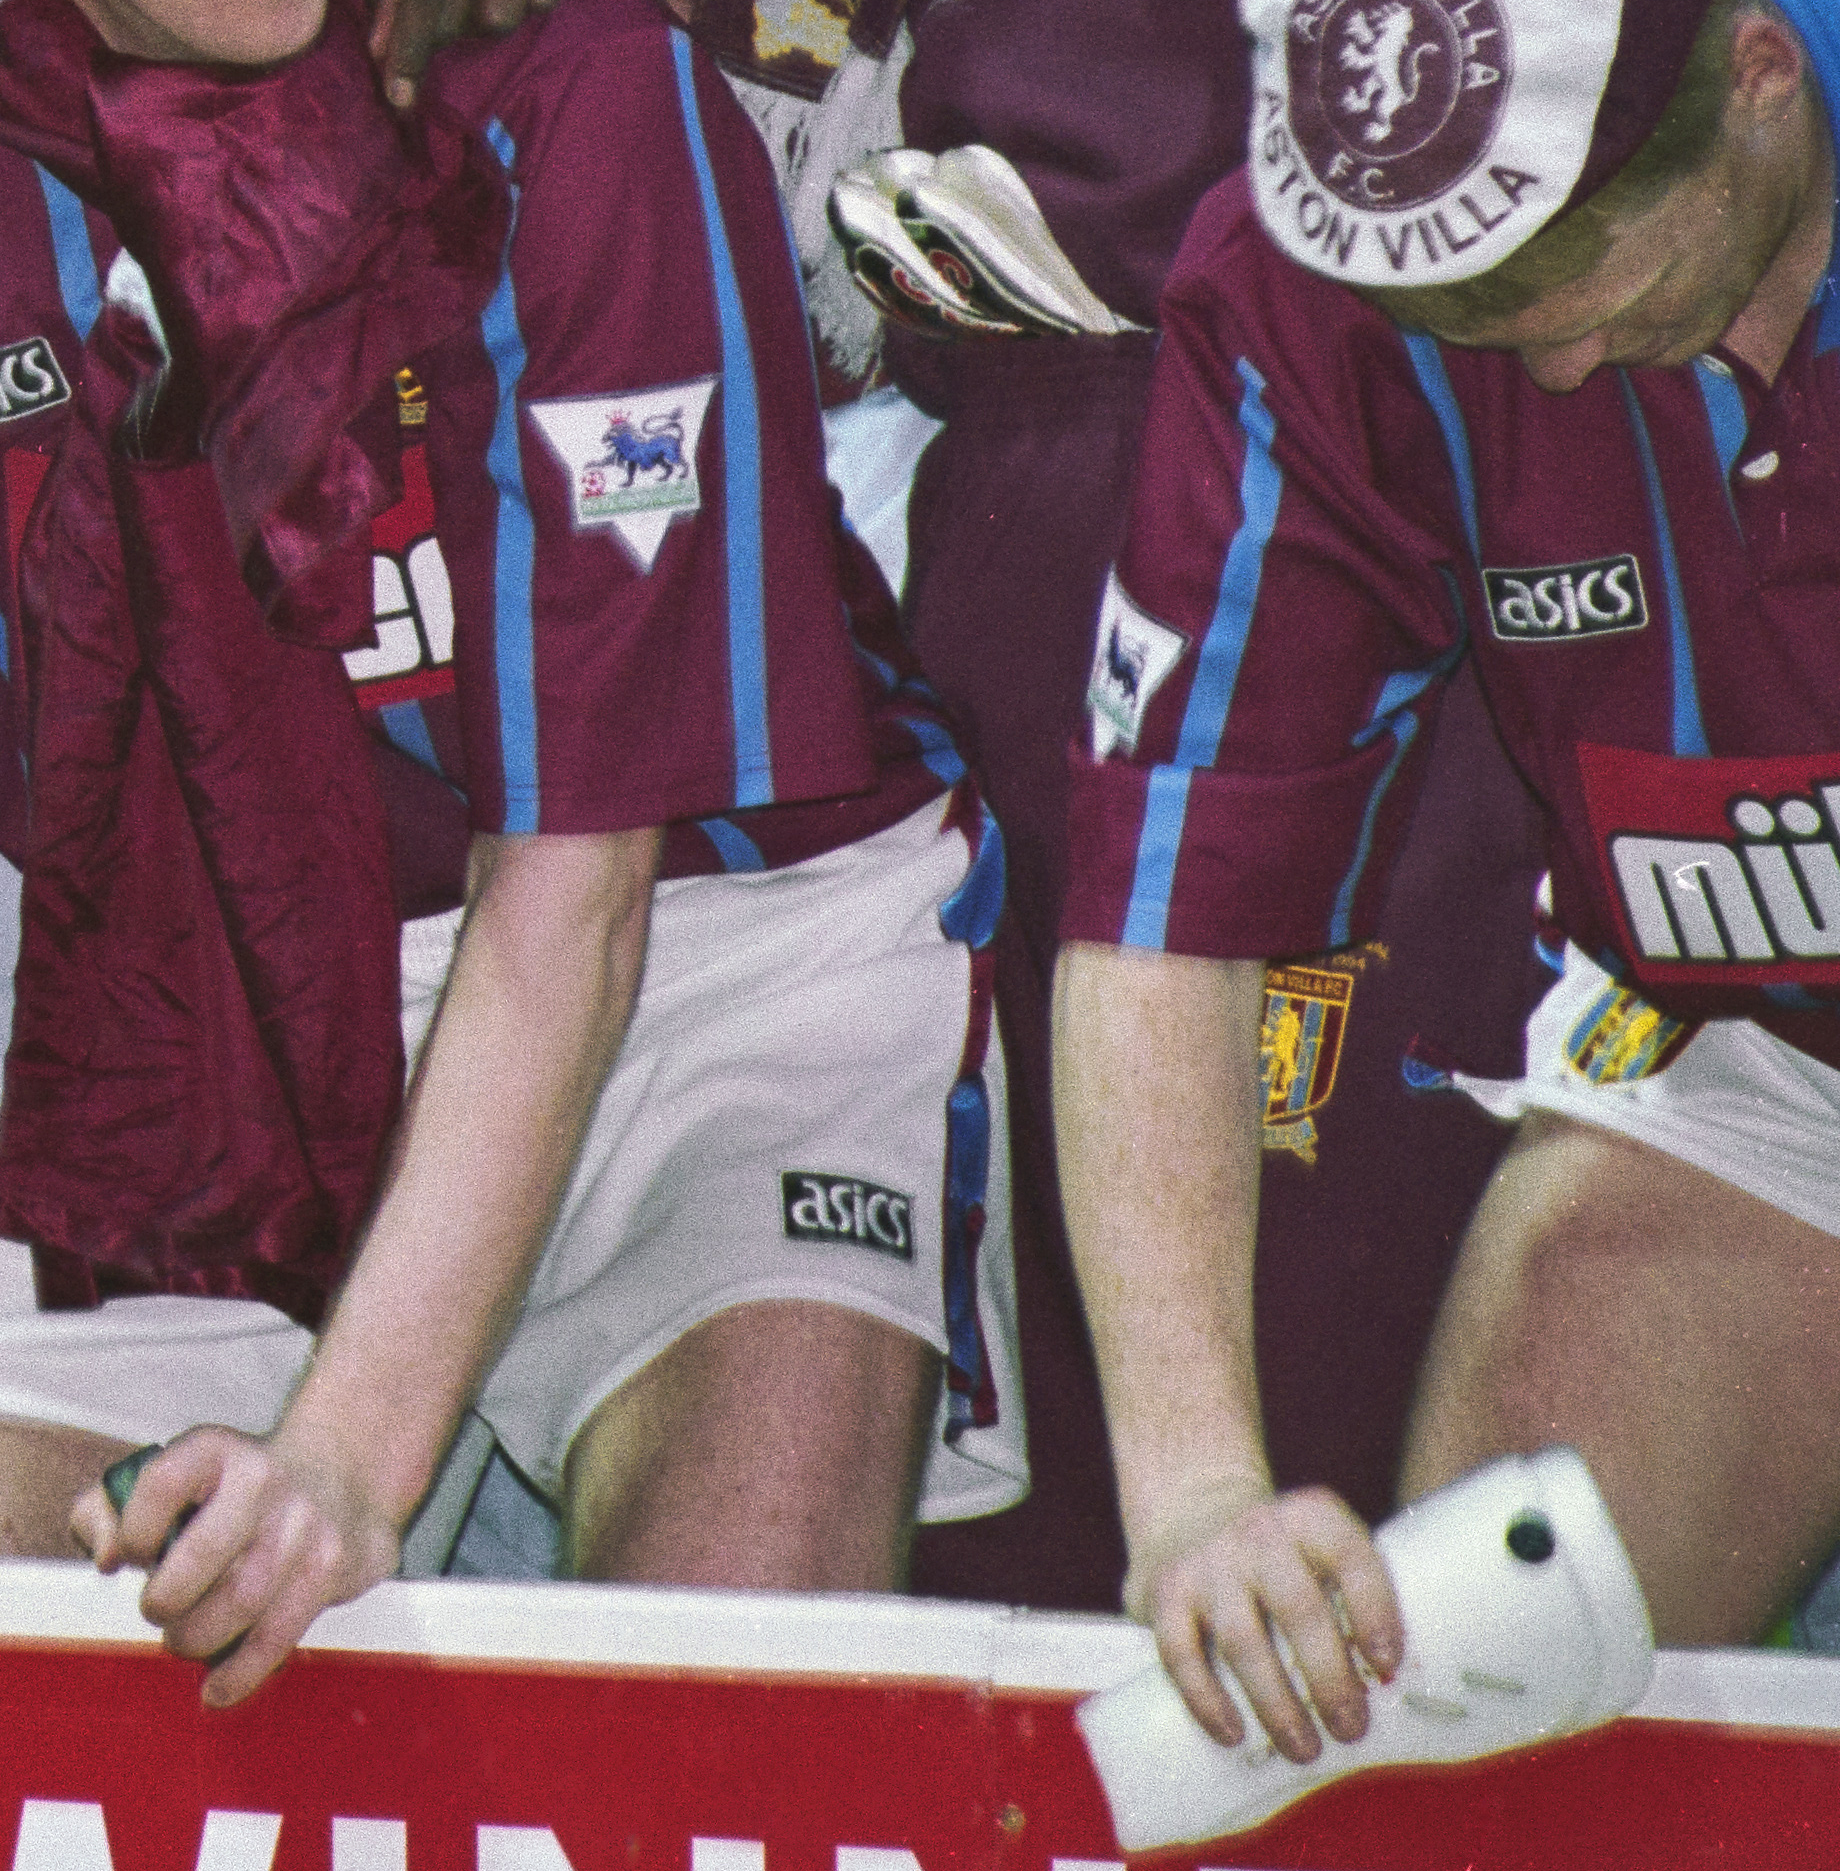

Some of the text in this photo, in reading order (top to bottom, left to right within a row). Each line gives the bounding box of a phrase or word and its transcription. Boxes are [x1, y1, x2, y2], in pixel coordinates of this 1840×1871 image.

[1264, 89, 1541, 272] ASTON VILLA
[1499, 565, 1633, 629] asics
[792, 1180, 908, 1249] asics
